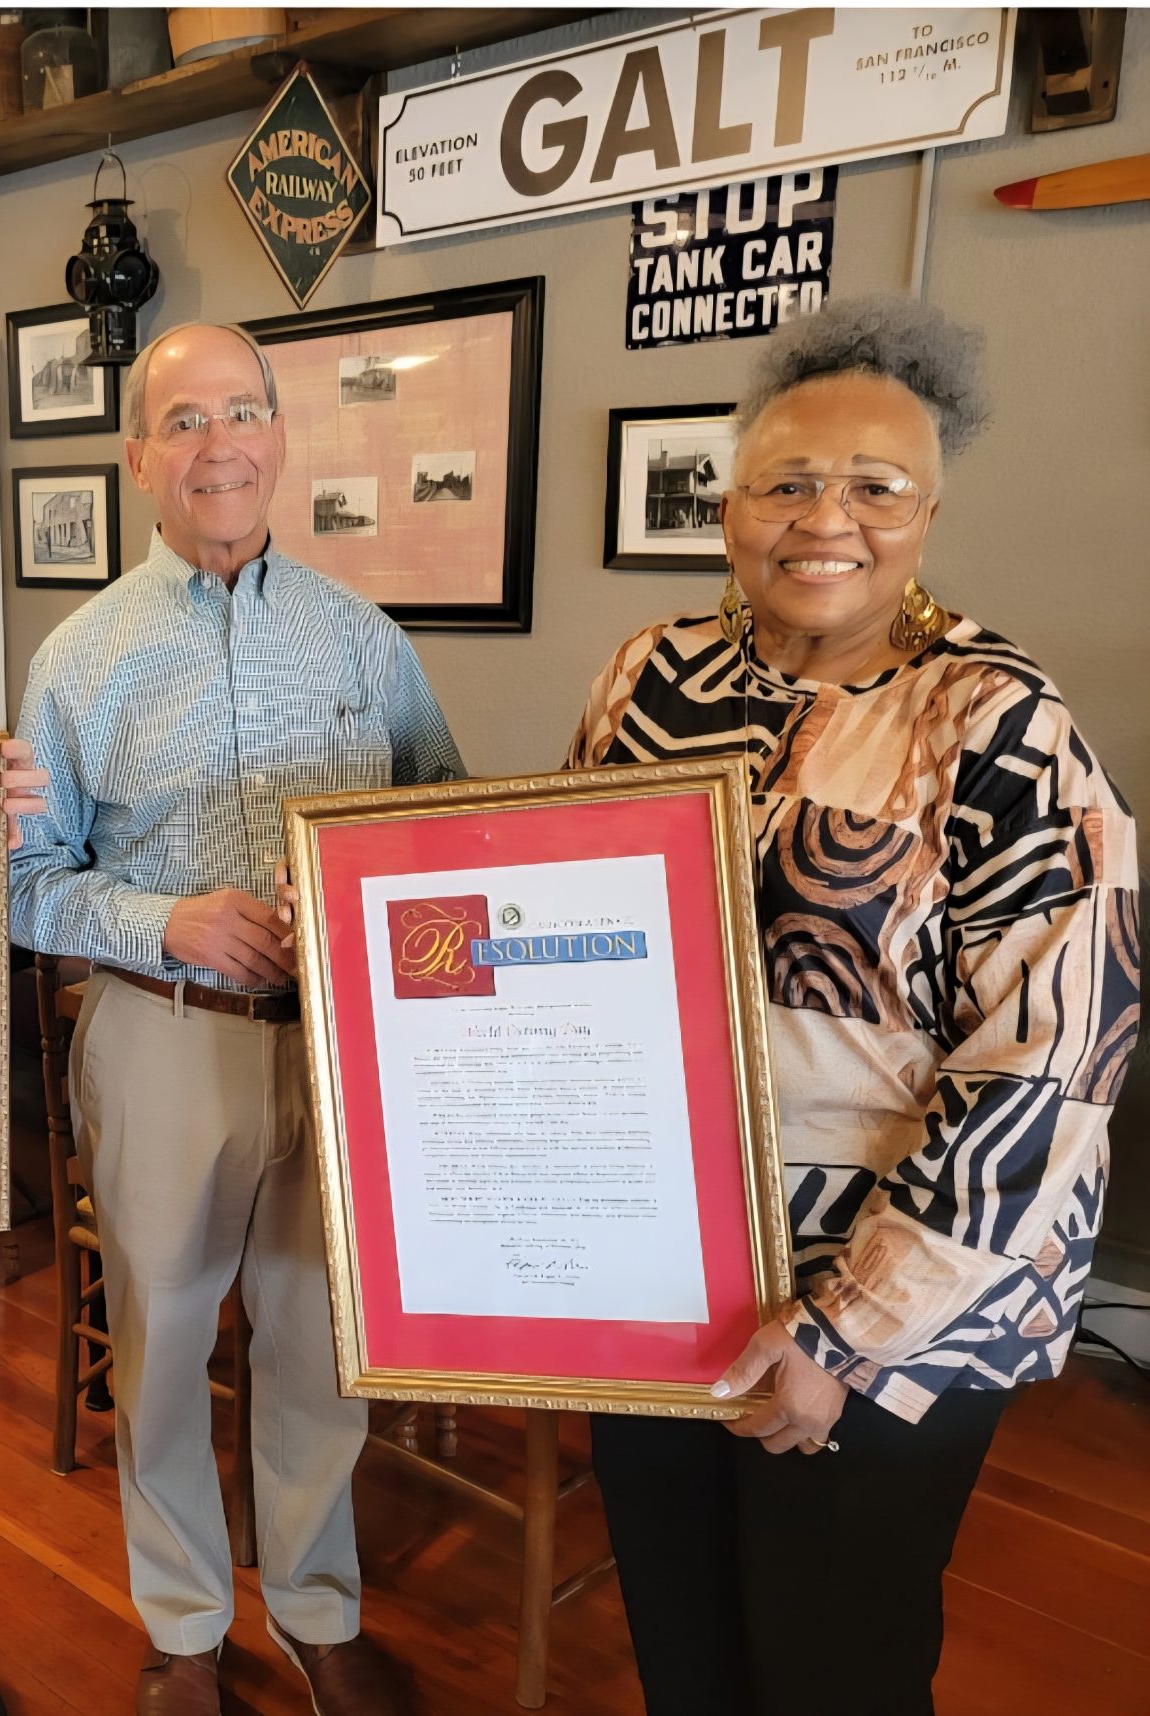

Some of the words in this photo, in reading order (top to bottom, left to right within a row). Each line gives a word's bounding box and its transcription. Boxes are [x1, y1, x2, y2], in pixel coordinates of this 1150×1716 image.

[856, 53, 888, 71] SAN
[896, 32, 989, 62] FRANCISCO
[912, 25, 933, 39] TO
[500, 8, 835, 197] GALT
[248, 129, 359, 196] AMERICAN
[396, 132, 478, 164] ELEVATION
[249, 185, 353, 244] EXPRESS
[265, 170, 339, 204] RAILWAY
[641, 167, 824, 248] STOP
[634, 245, 726, 295] TANK
[742, 231, 823, 280] CAR
[632, 280, 823, 340] CONNECTED
